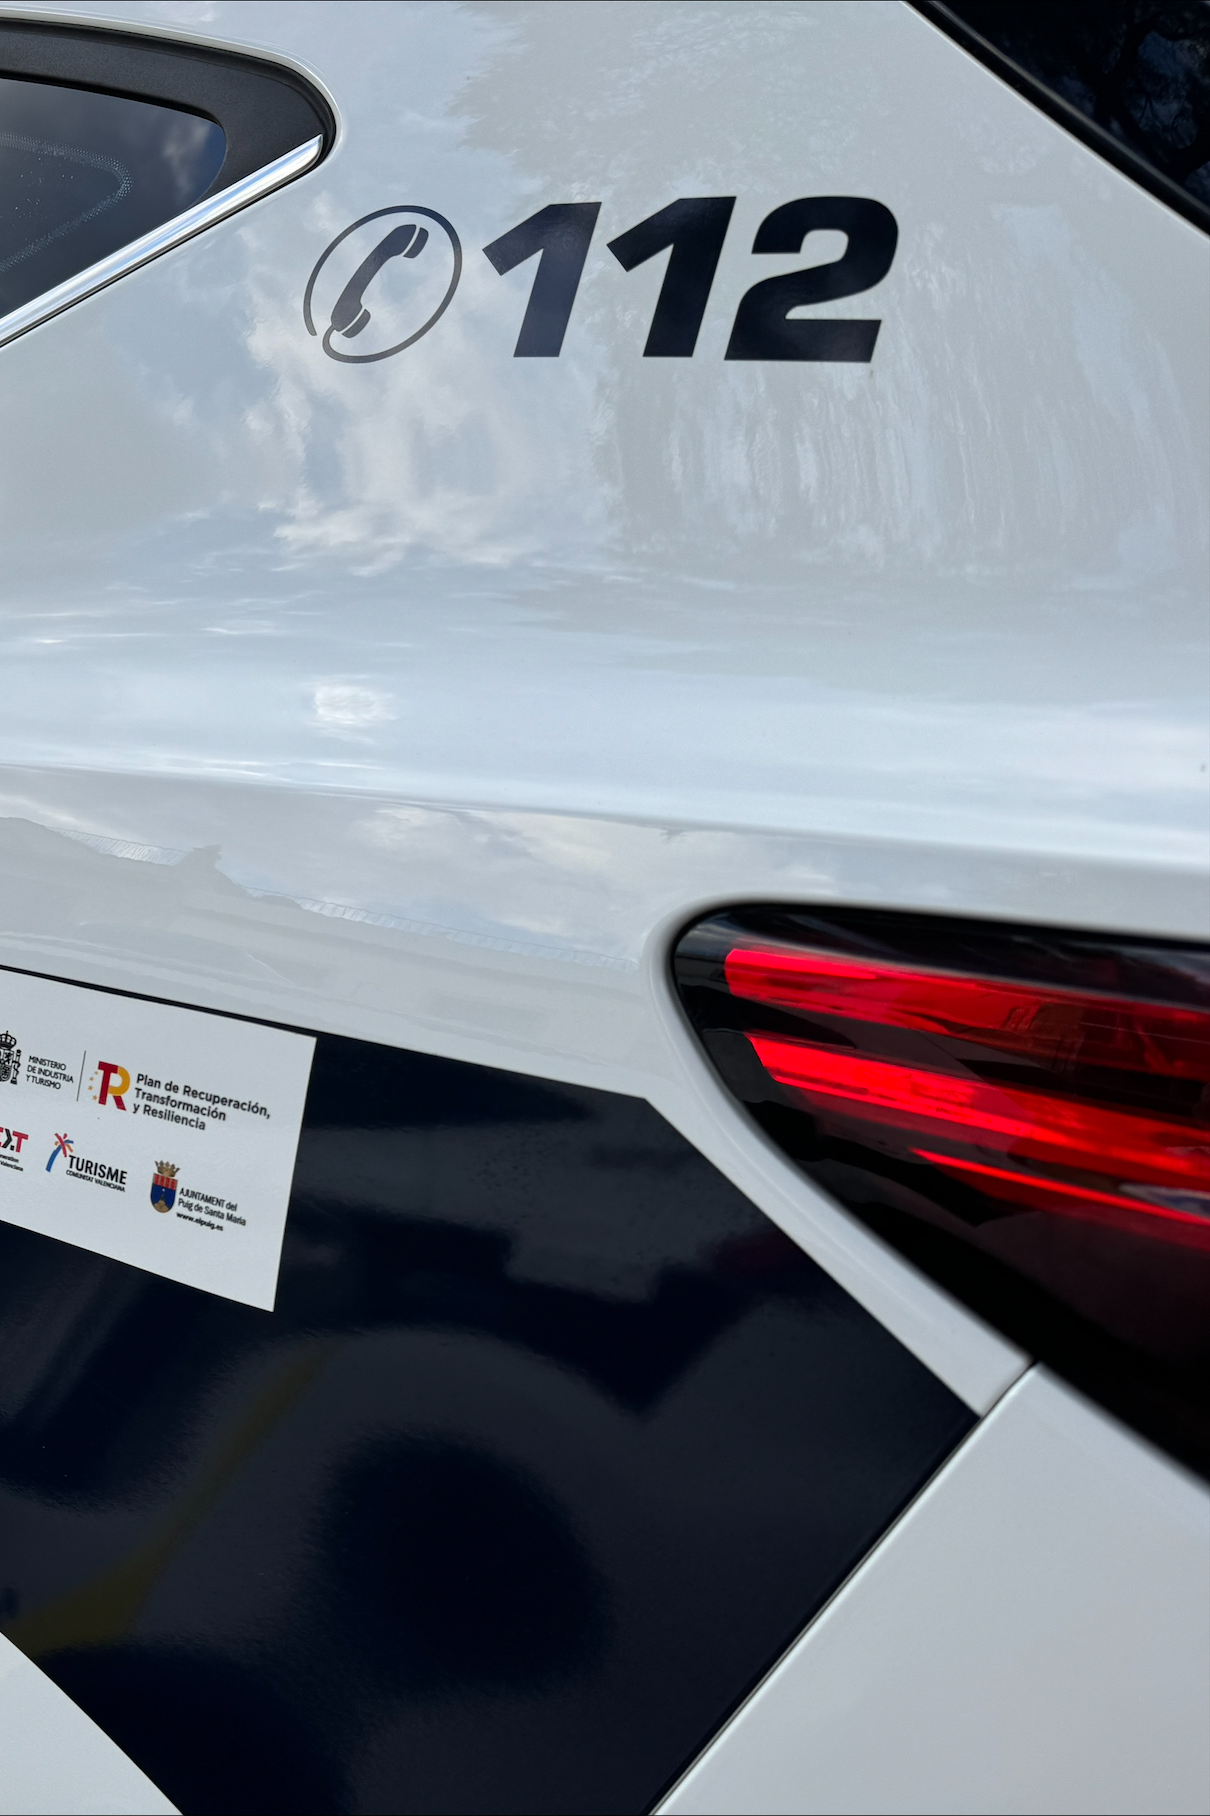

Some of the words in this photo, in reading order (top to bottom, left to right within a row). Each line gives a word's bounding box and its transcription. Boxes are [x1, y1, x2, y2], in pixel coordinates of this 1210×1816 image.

[482, 195, 899, 363] 112
[27, 1065, 37, 1076] DE
[37, 1066, 74, 1084] INDUSTRIA
[28, 1055, 67, 1071] MINISTERIO
[31, 1076, 62, 1090] TURISMO
[136, 1073, 161, 1089] Plan
[164, 1080, 180, 1094] de
[182, 1084, 271, 1119] Recuperación,
[132, 1103, 141, 1114] y
[143, 1105, 206, 1131] Resiliencia
[135, 1087, 227, 1121] Transformación
[68, 1154, 128, 1185] TURISME
[177, 1198, 193, 1212] Puig
[193, 1203, 203, 1213] de
[203, 1206, 225, 1219] Santa
[179, 1187, 226, 1208] AJUNTAMENT
[225, 1201, 238, 1211] del
